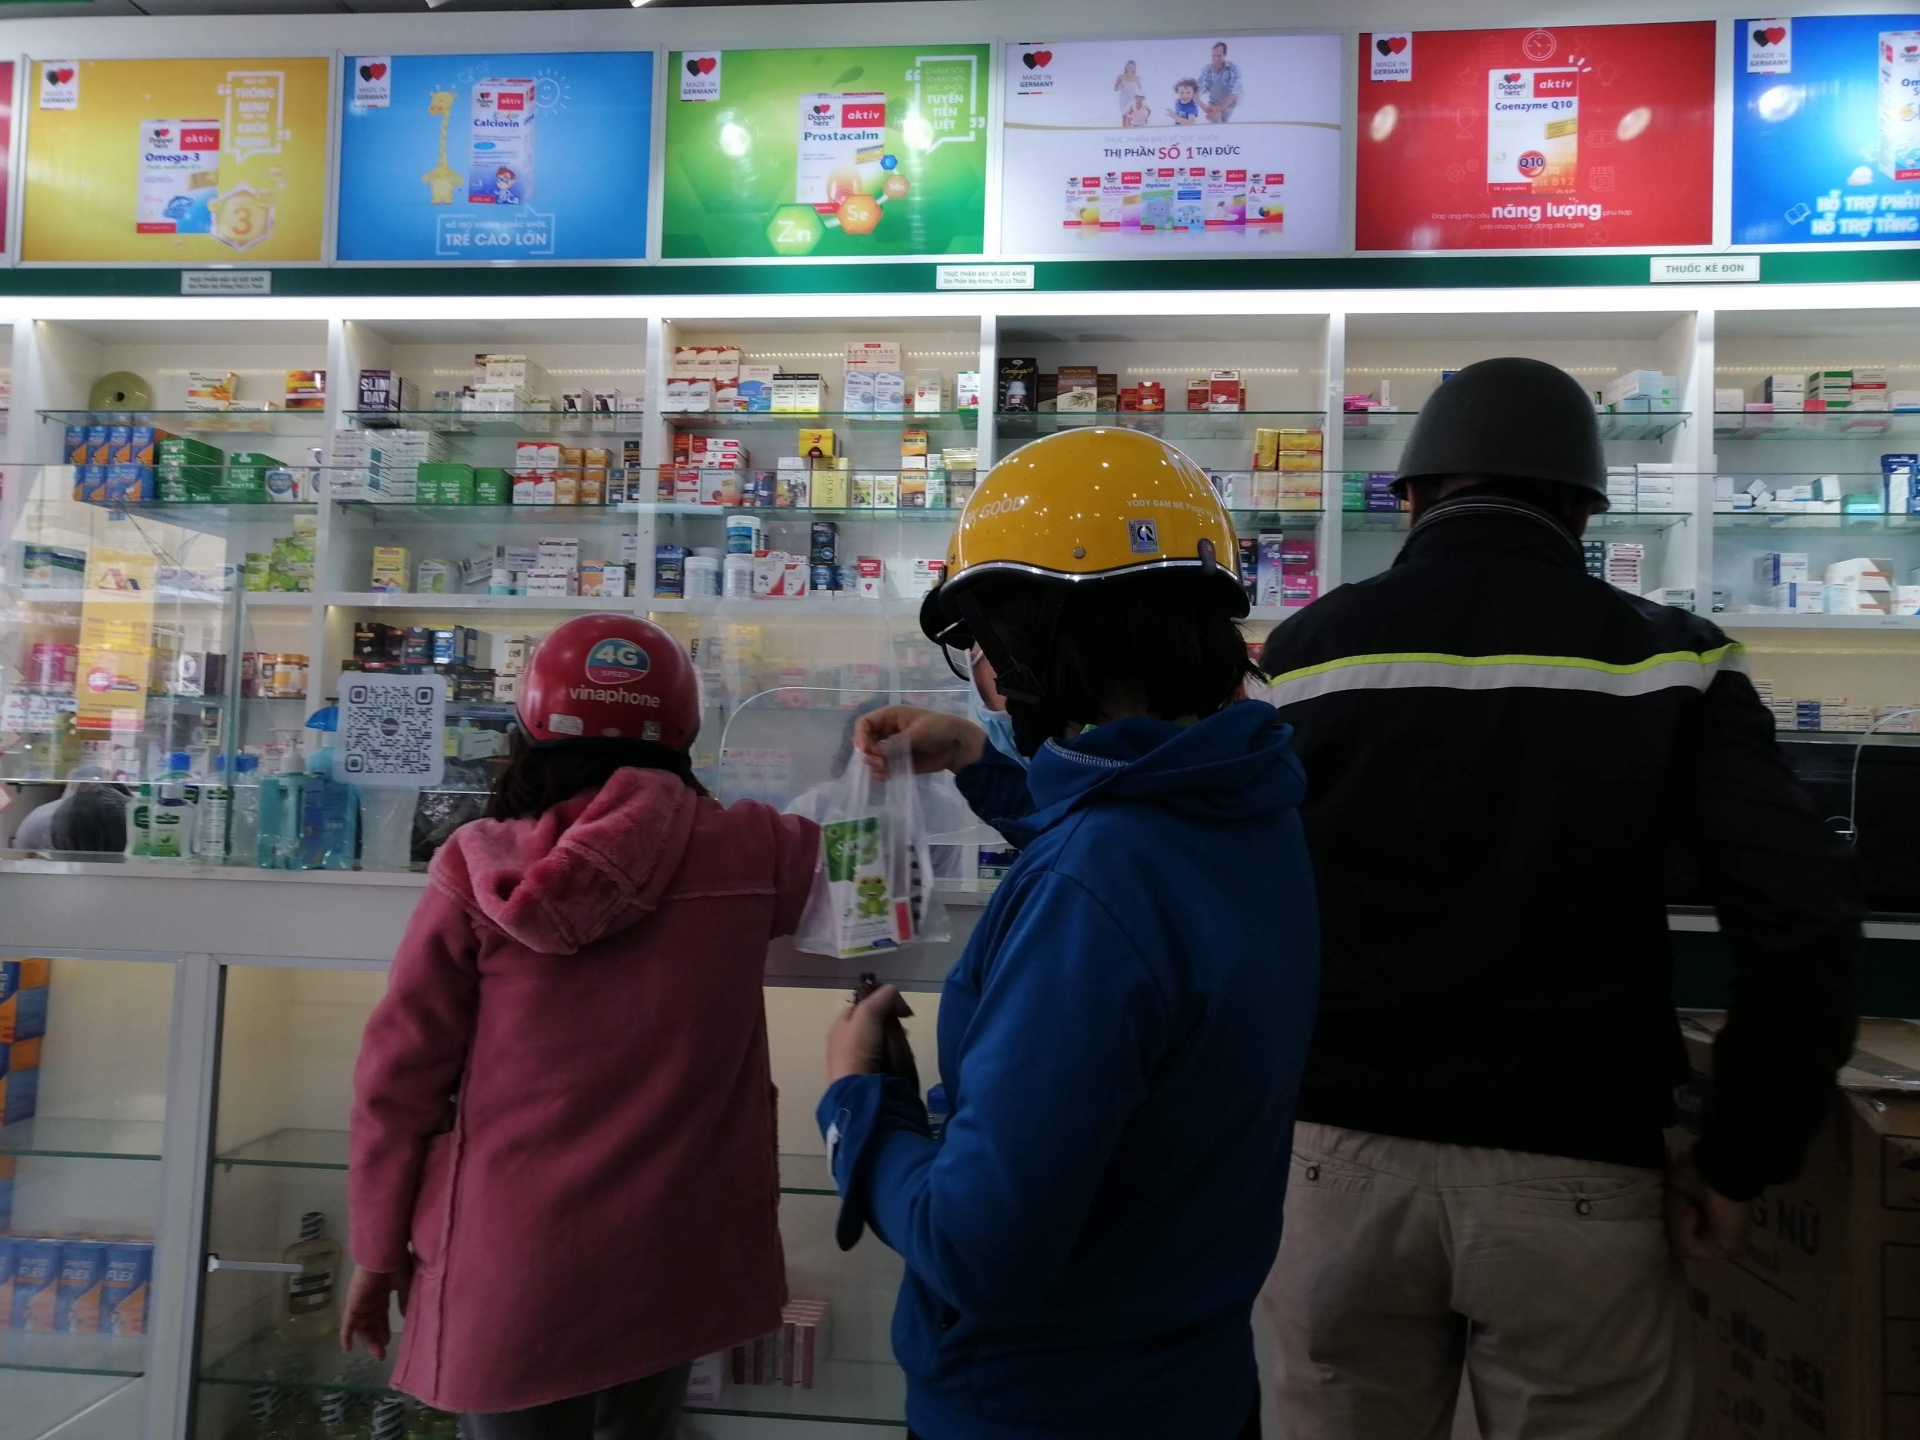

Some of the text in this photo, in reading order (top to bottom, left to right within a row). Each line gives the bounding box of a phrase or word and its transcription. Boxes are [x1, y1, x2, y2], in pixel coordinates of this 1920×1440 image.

[1539, 79, 1573, 89] aktiv
[926, 91, 964, 104] TUYẾN
[1495, 100, 1573, 112] Coenzyme Q10
[807, 113, 835, 121] Doppel
[847, 110, 881, 120] aktiv
[474, 119, 519, 128] Calciovin
[184, 134, 215, 144] aktiv
[804, 131, 879, 141] Prostacalm
[1103, 142, 1240, 160] THỊ PHẦN SỐ 1 TẠI ĐỨC
[145, 152, 200, 164] Omega-3
[1519, 157, 1544, 168] Q10
[1844, 195, 1878, 214] TRỢ
[846, 205, 869, 222] Se
[1492, 203, 1541, 222] năng
[1546, 202, 1602, 221] lượng
[231, 206, 253, 235] 3
[776, 219, 812, 242] Zn
[1838, 217, 1873, 238] TRỢ
[445, 229, 471, 246] TRẺ
[475, 232, 511, 246] CAO
[1666, 262, 1744, 273] THUỐC KÊ ĐƠN
[363, 391, 387, 403] DAY
[981, 496, 1026, 518] GOOD
[1126, 500, 1151, 508] YODY
[1153, 500, 1172, 508] ĐAM
[595, 645, 639, 666] 4G
[601, 669, 630, 679] SPEED
[569, 684, 661, 708] vinaphone
